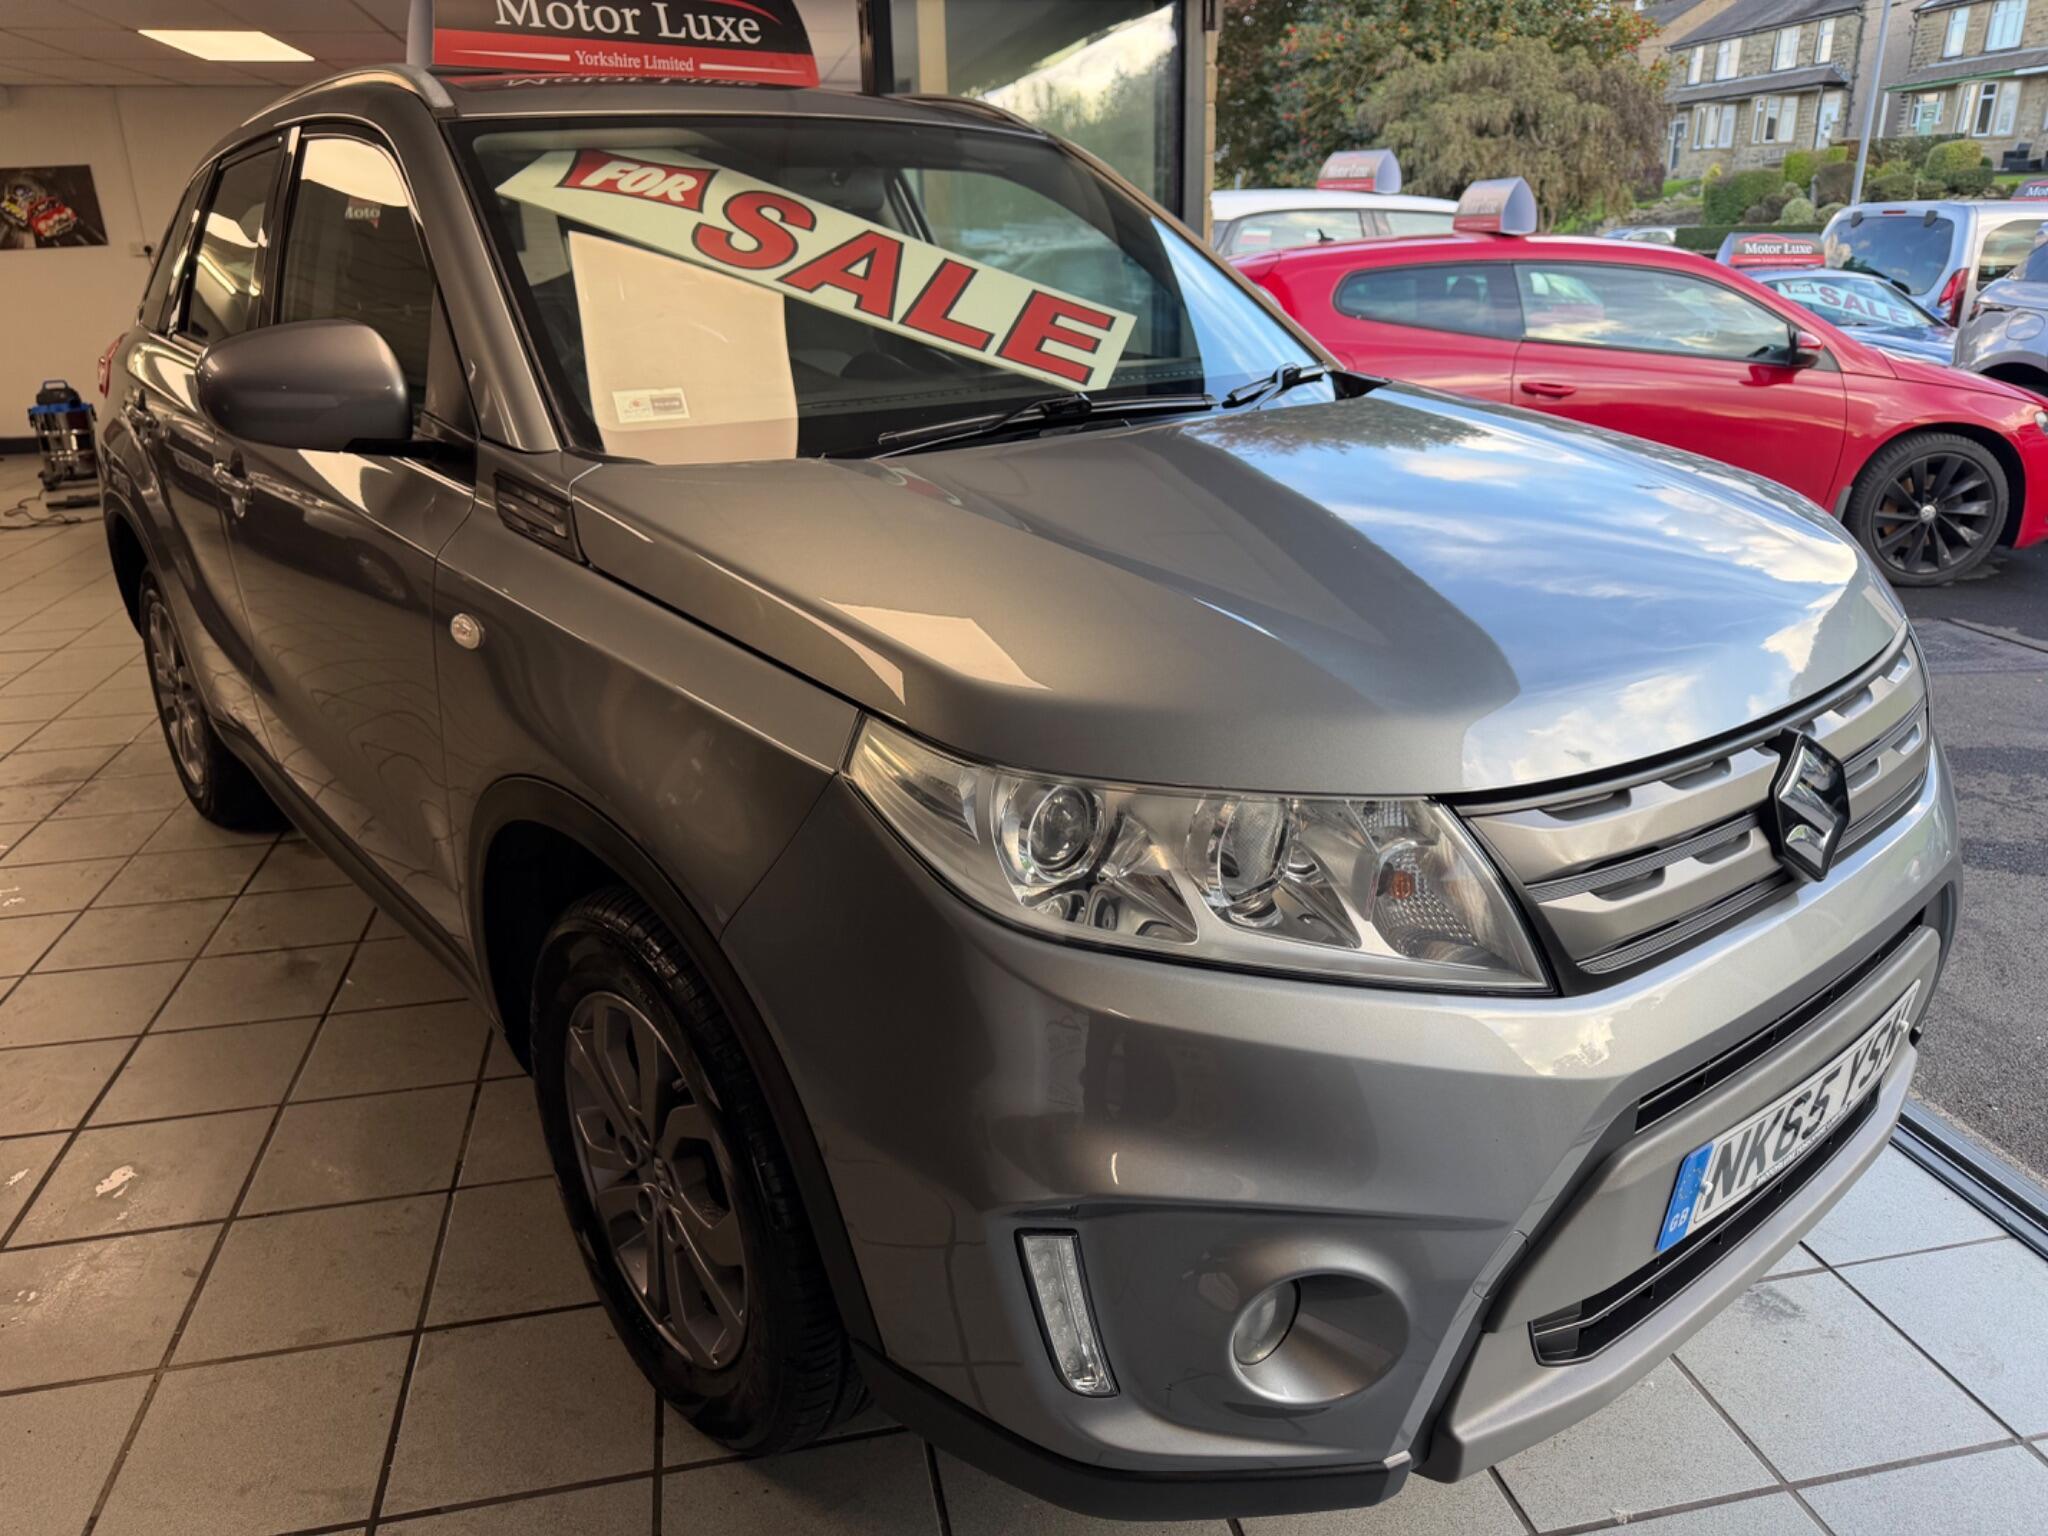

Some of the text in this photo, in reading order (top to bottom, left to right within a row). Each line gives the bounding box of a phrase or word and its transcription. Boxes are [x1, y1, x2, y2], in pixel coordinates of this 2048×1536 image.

[495, 0, 762, 45] Motor Luxe
[575, 50, 694, 72] Yorkshire Limited
[1744, 243, 1813, 255] Motor Luxe
[580, 160, 1117, 386] FOR SALE
[1819, 286, 1909, 322] SALE
[1702, 1067, 1841, 1211] NK65
[1669, 1206, 1690, 1232] GB
